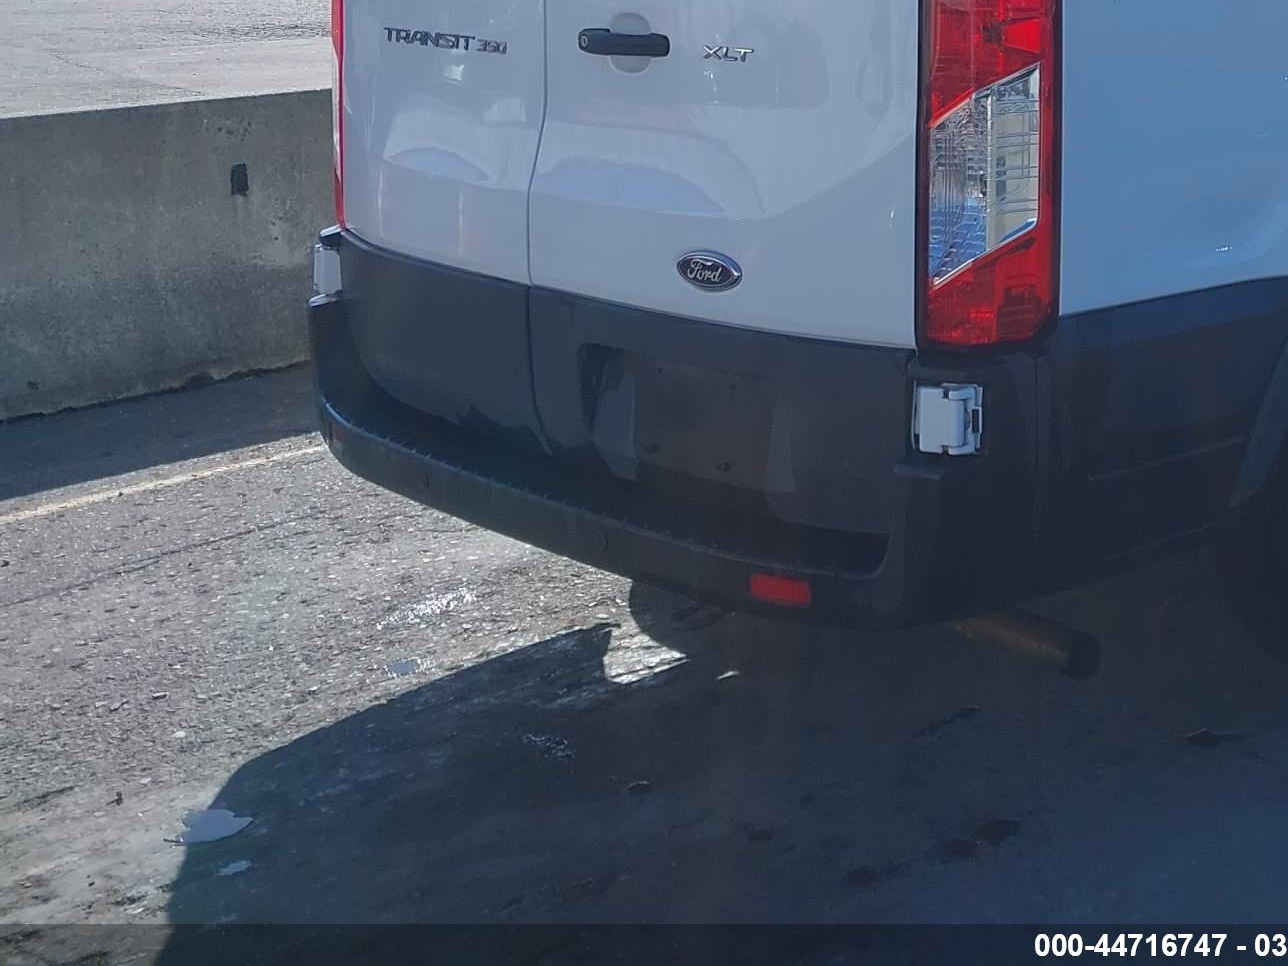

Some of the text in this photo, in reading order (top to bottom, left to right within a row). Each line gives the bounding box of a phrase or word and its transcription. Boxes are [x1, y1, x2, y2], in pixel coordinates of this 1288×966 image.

[384, 27, 475, 51] TRANSIT
[703, 44, 754, 62] XLT
[687, 258, 722, 282] Ford
